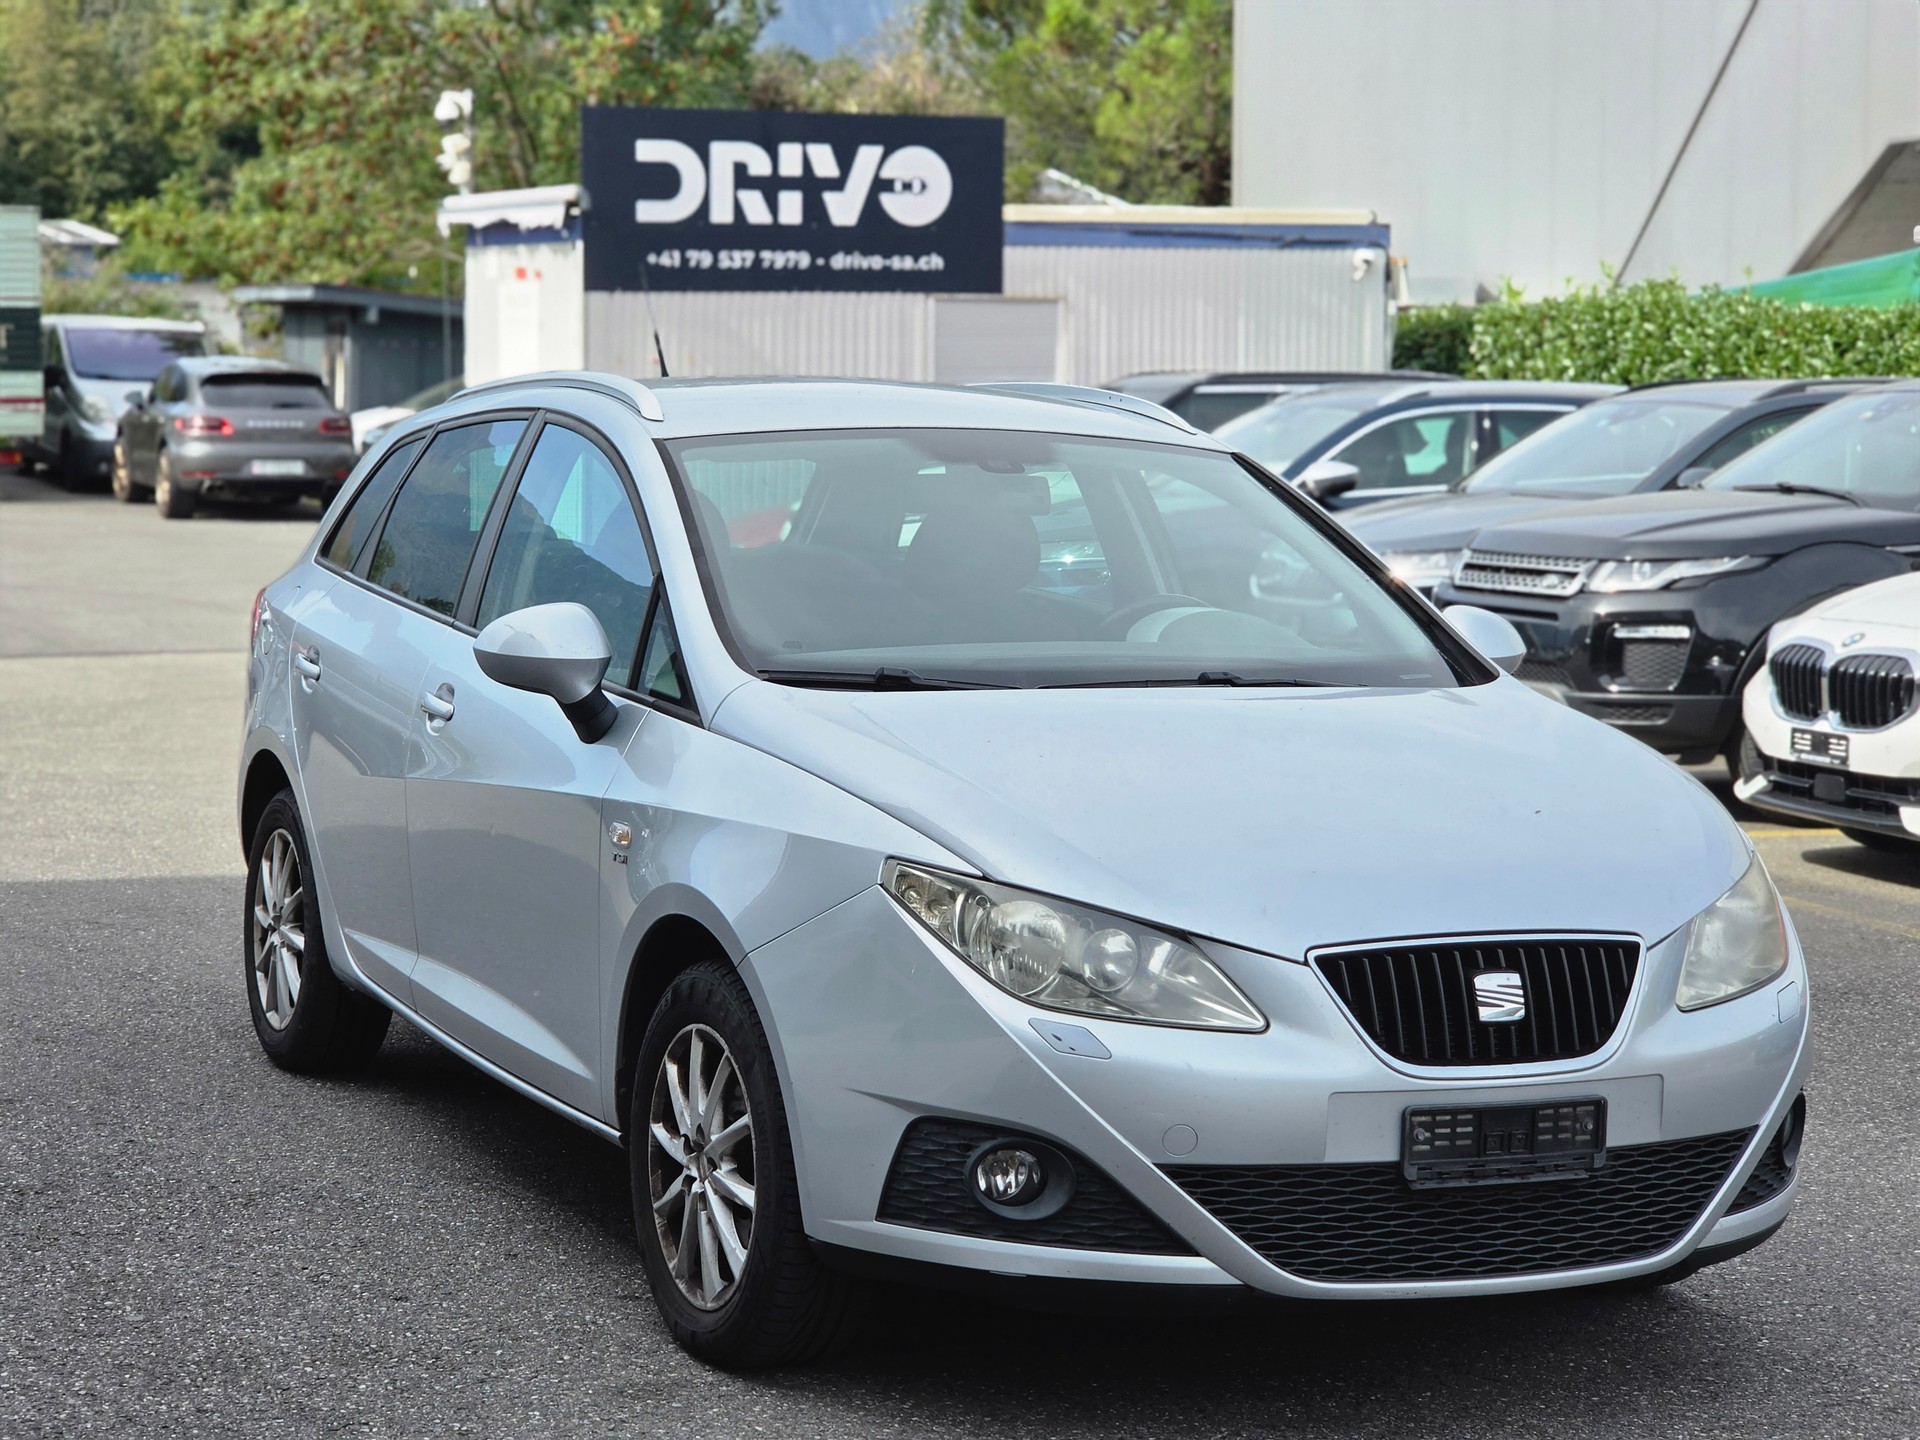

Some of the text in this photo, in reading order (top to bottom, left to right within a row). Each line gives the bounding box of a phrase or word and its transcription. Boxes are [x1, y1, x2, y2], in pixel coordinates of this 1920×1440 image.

[635, 138, 953, 227] DRIVO
[646, 249, 682, 269] +41
[685, 249, 714, 270] 79
[717, 249, 756, 270] 537
[759, 250, 812, 271] 7979
[829, 250, 945, 271] drivo-sa.ch
